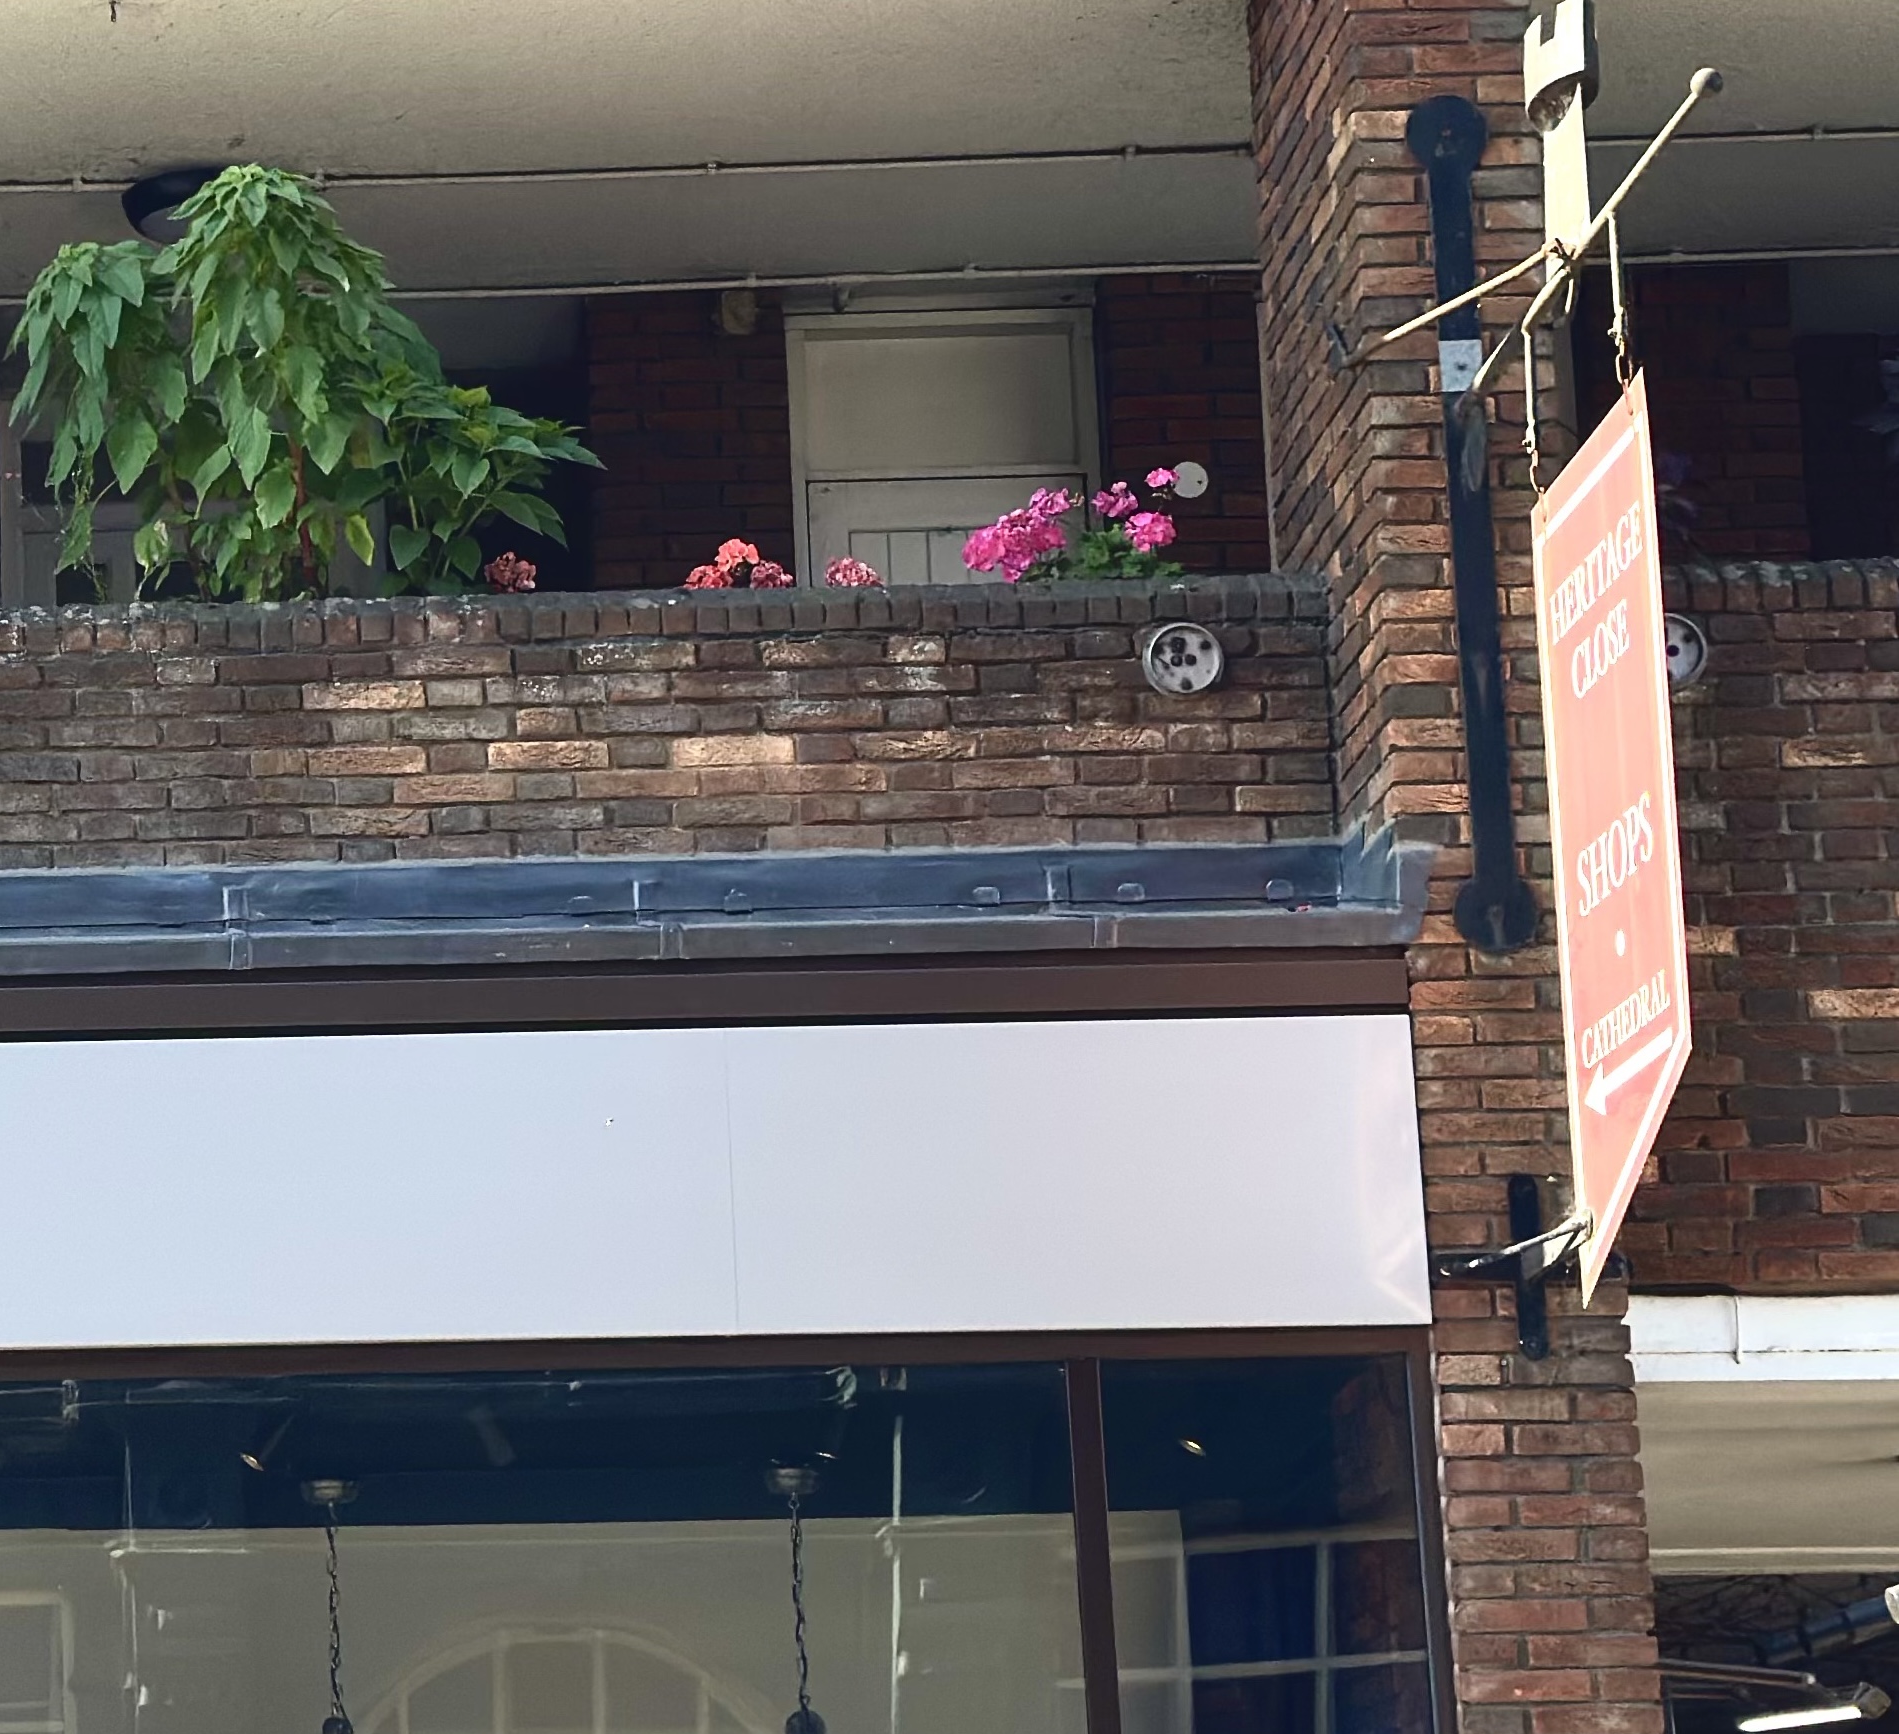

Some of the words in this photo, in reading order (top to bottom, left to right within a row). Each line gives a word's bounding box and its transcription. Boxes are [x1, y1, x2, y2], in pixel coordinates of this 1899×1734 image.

[1550, 501, 1643, 645] HERITAGE
[1571, 599, 1630, 699] CLOSE
[1576, 791, 1653, 916] SHOPS
[1581, 969, 1671, 1069] CATHEDRAL
